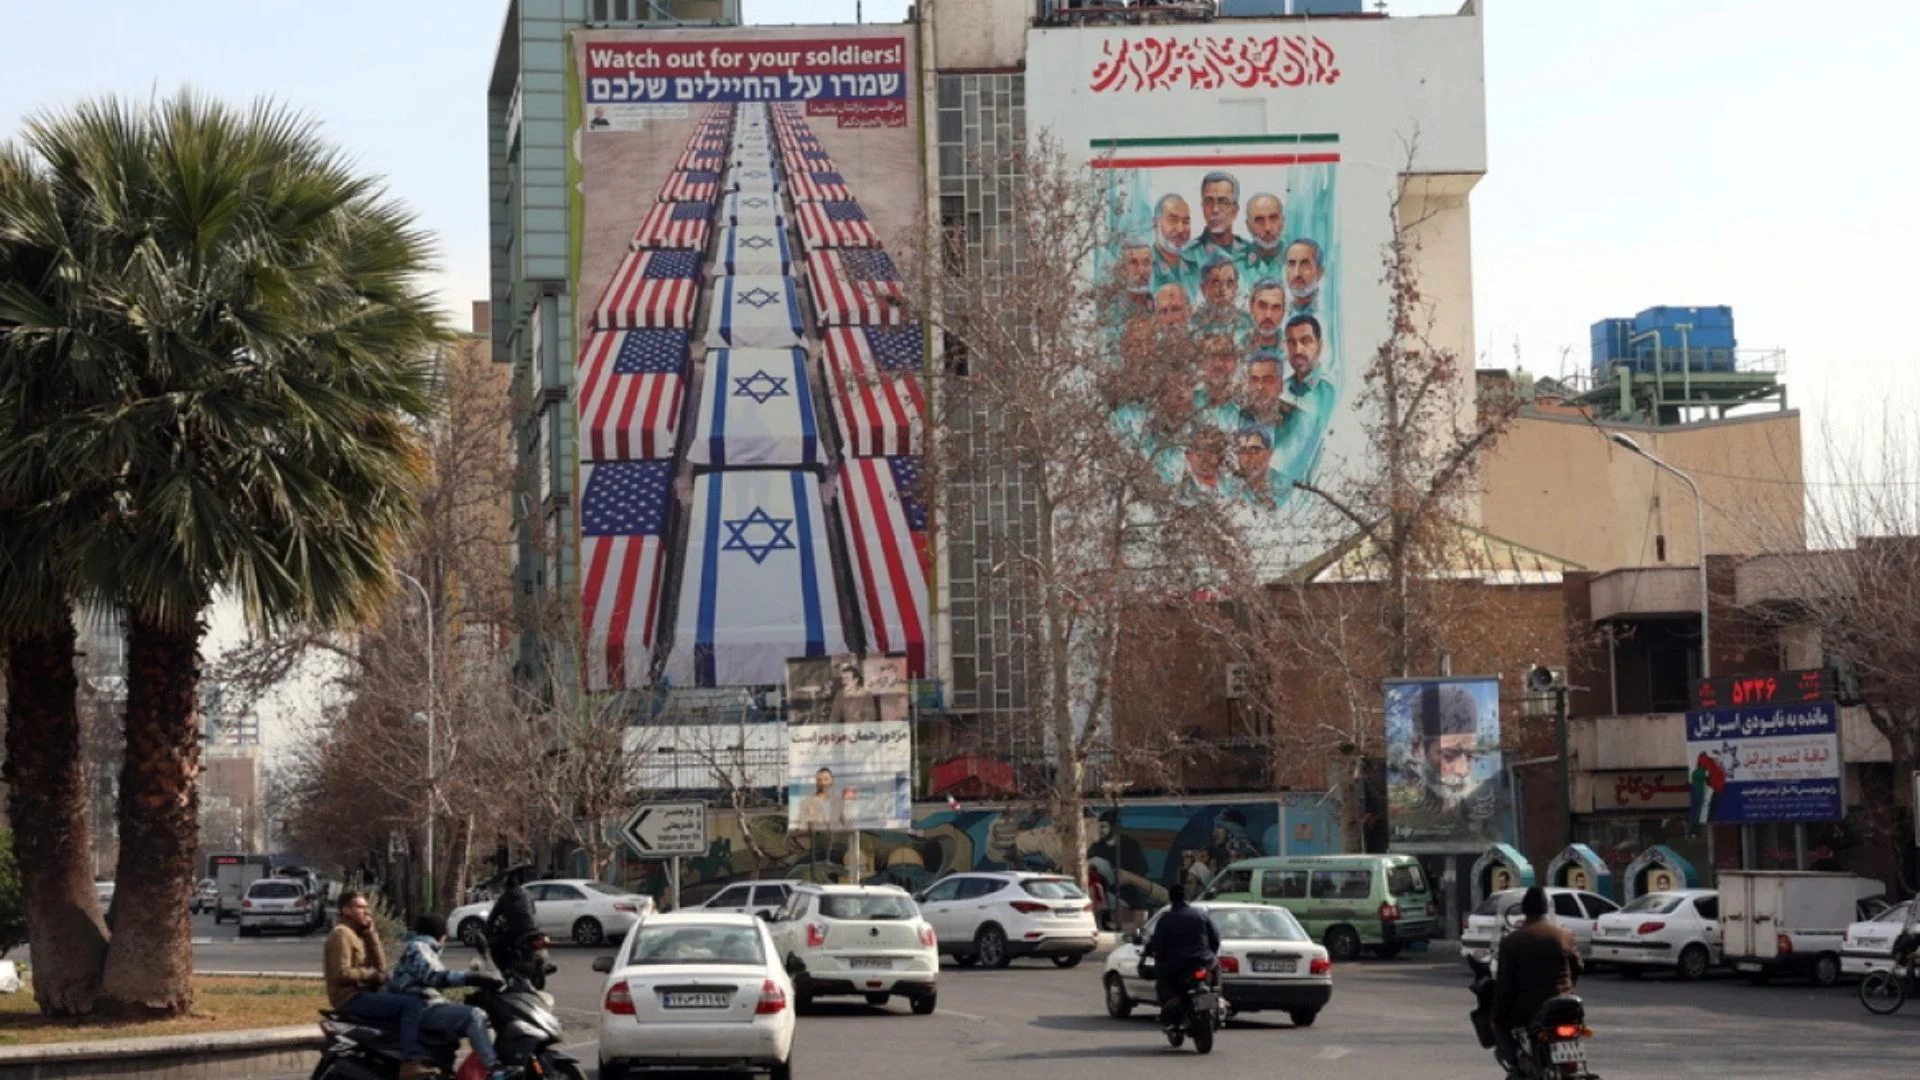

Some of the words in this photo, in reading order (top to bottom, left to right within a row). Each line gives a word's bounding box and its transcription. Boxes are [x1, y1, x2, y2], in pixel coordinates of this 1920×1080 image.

[591, 49, 661, 68] Watch
[666, 51, 706, 68] out
[709, 48, 743, 67] for
[749, 51, 801, 72] your
[806, 45, 901, 66] soldiers!
[591, 70, 667, 100] שלכם
[675, 69, 781, 99] החיילים
[787, 69, 823, 98] על
[830, 73, 899, 97] שמרו
